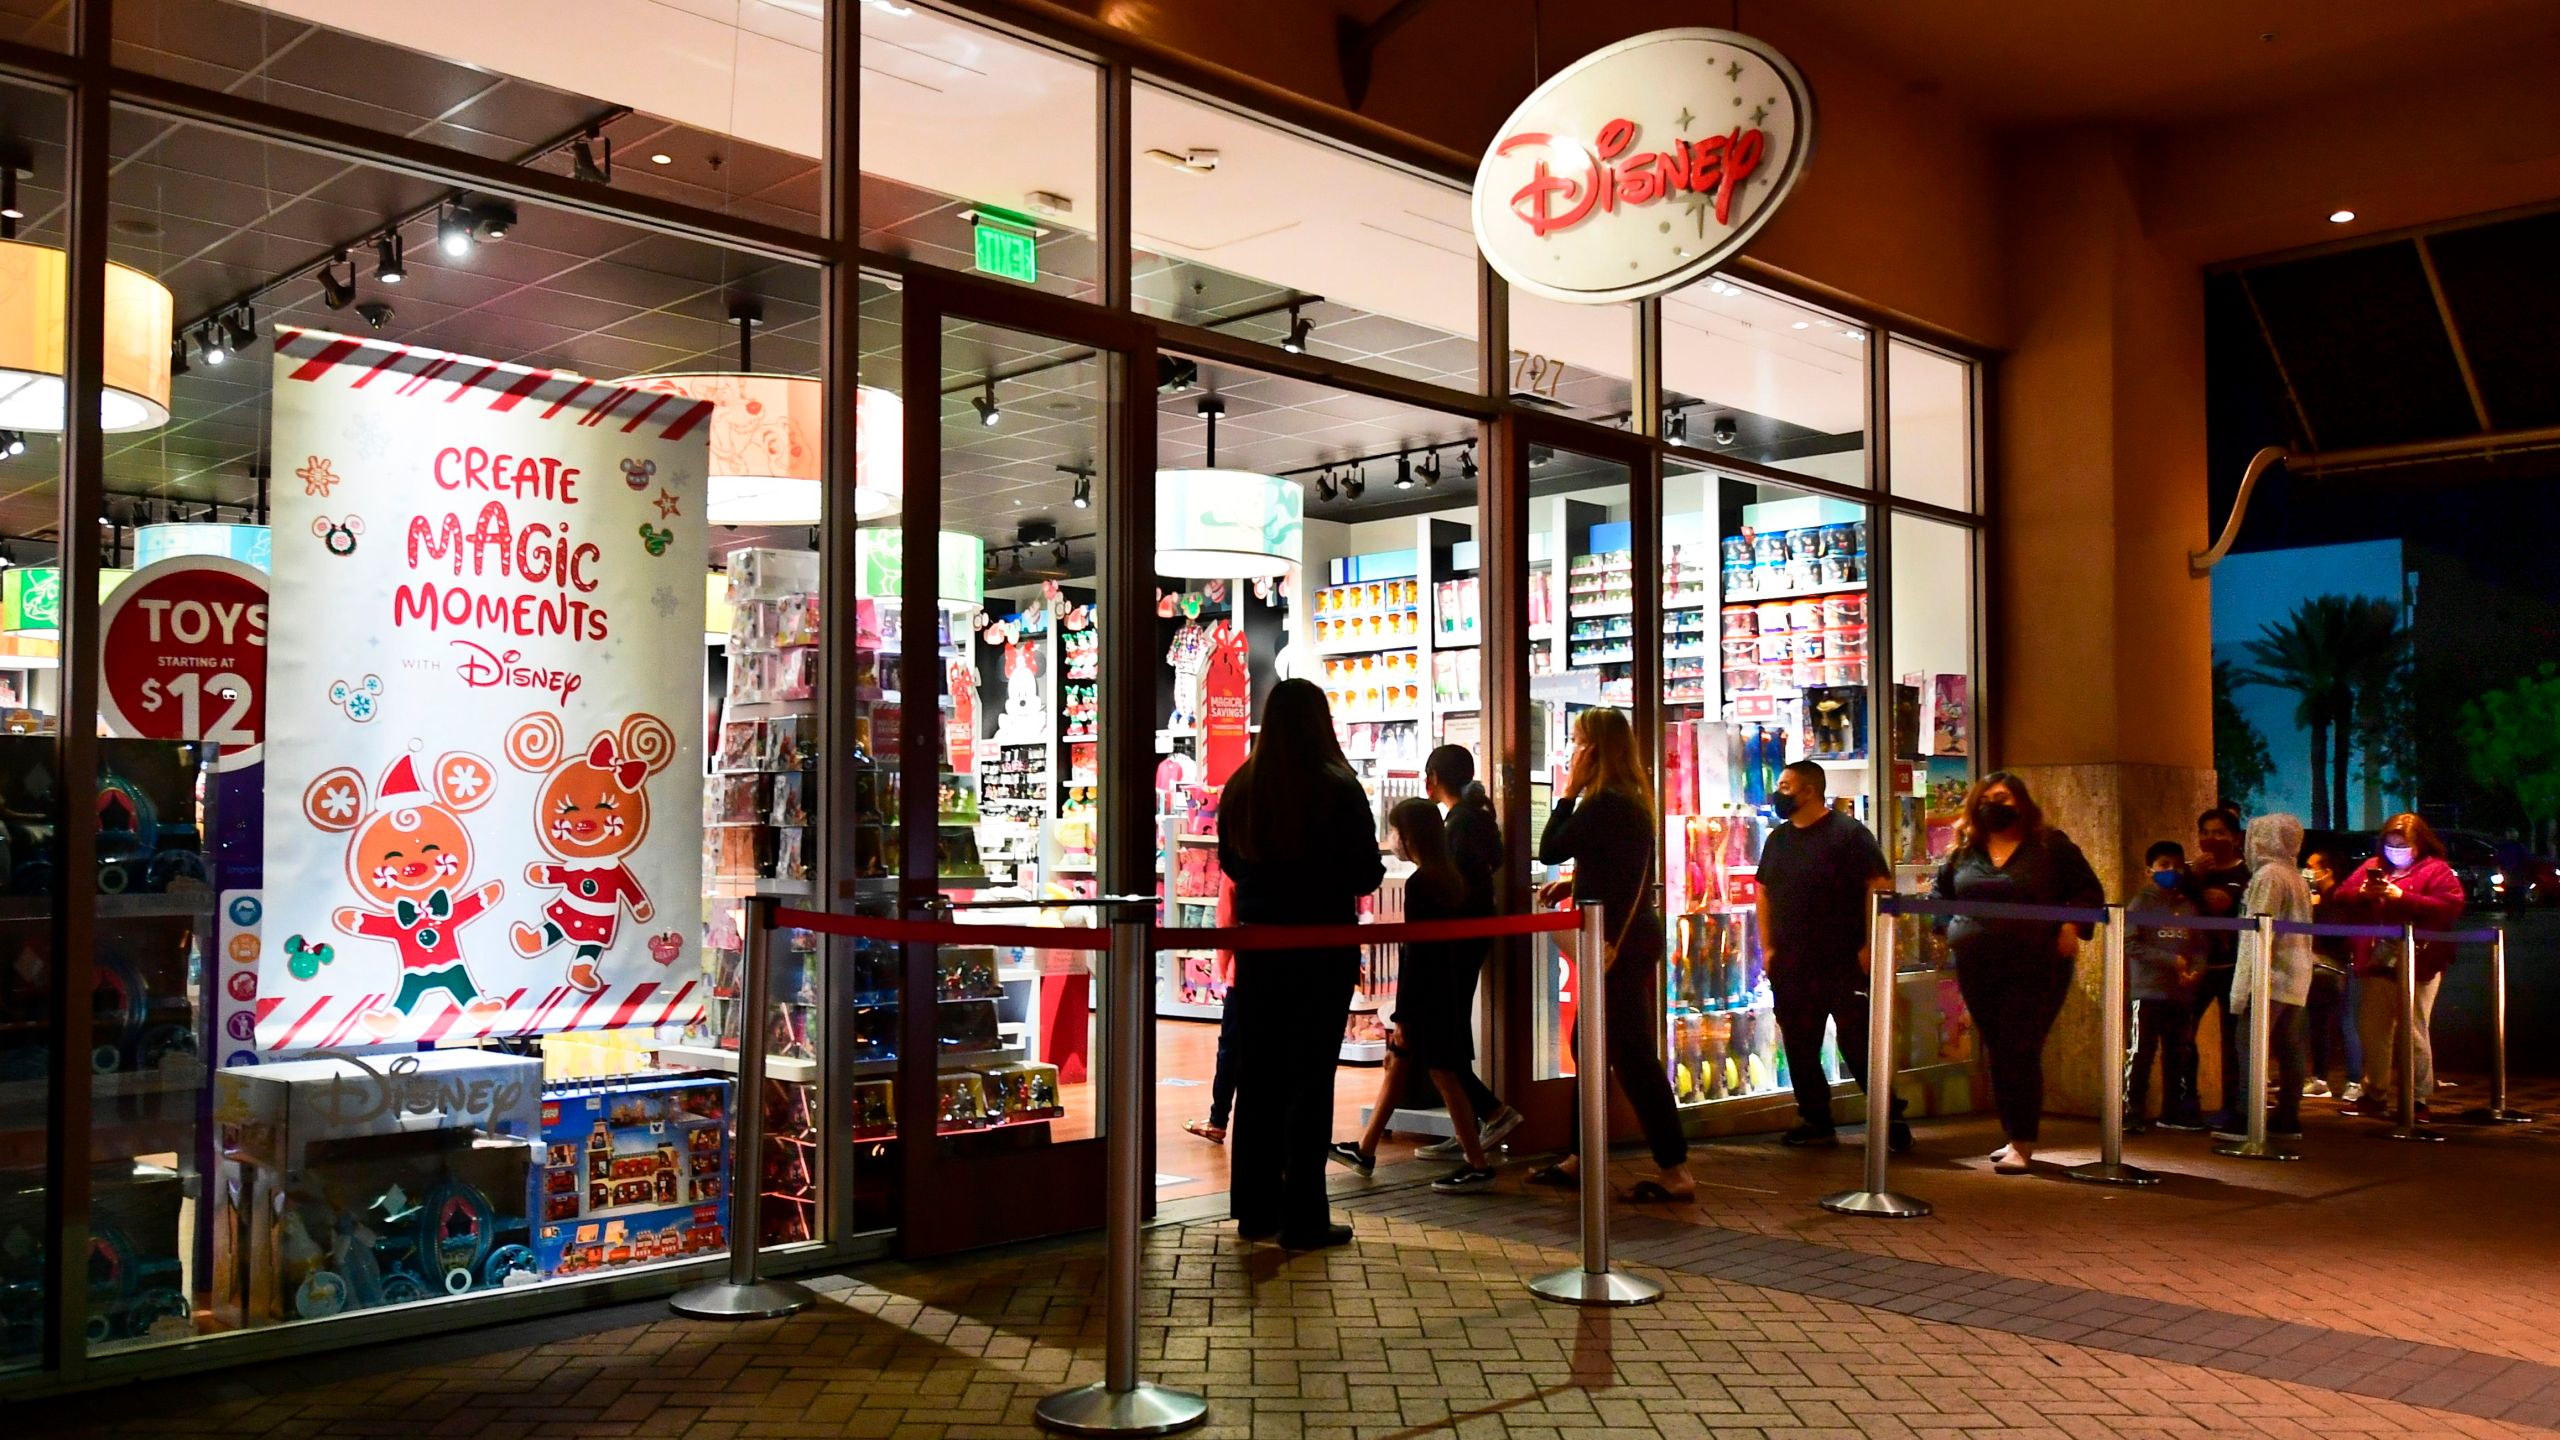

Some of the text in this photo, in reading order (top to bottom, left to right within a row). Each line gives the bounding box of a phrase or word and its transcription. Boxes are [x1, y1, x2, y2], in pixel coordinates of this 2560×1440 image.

[1495, 118, 1764, 236] Disney
[1514, 350, 1564, 397] 727
[434, 446, 581, 503] CREATE
[138, 599, 268, 647] TOYS
[394, 581, 608, 641] MOMENTS
[158, 656, 235, 668] STARTING AT
[402, 640, 581, 707] WITH Disney
[141, 672, 256, 746] $12
[1210, 696, 1244, 708] MAGICAL
[1211, 707, 1245, 718] SAVINGS
[301, 1051, 521, 1139] Disney
